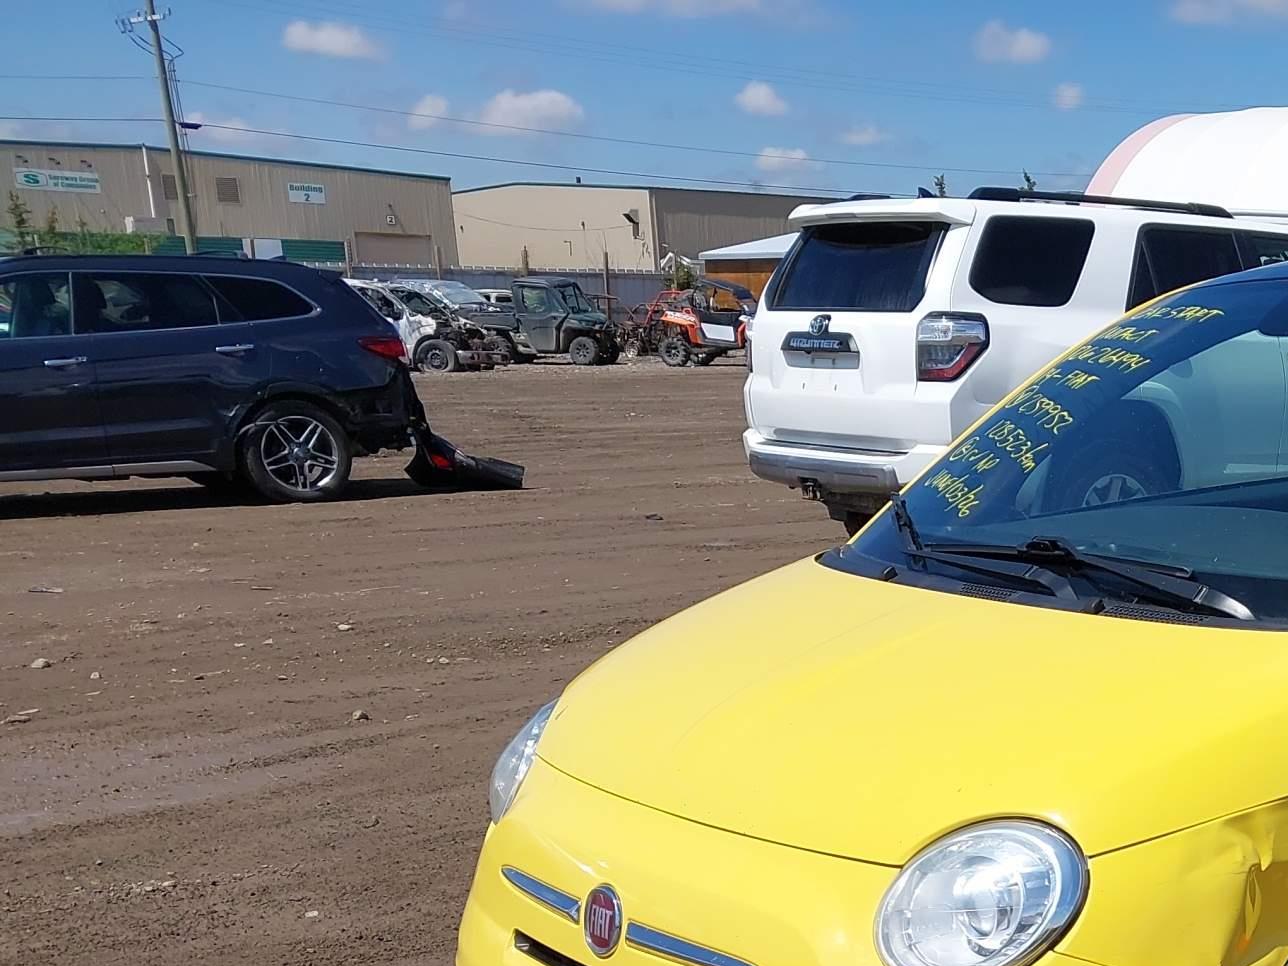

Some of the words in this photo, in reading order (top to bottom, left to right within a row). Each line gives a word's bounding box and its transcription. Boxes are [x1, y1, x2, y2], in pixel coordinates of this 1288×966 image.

[288, 184, 323, 193] Building
[304, 193, 310, 202] 2
[590, 903, 613, 940] FIAT
